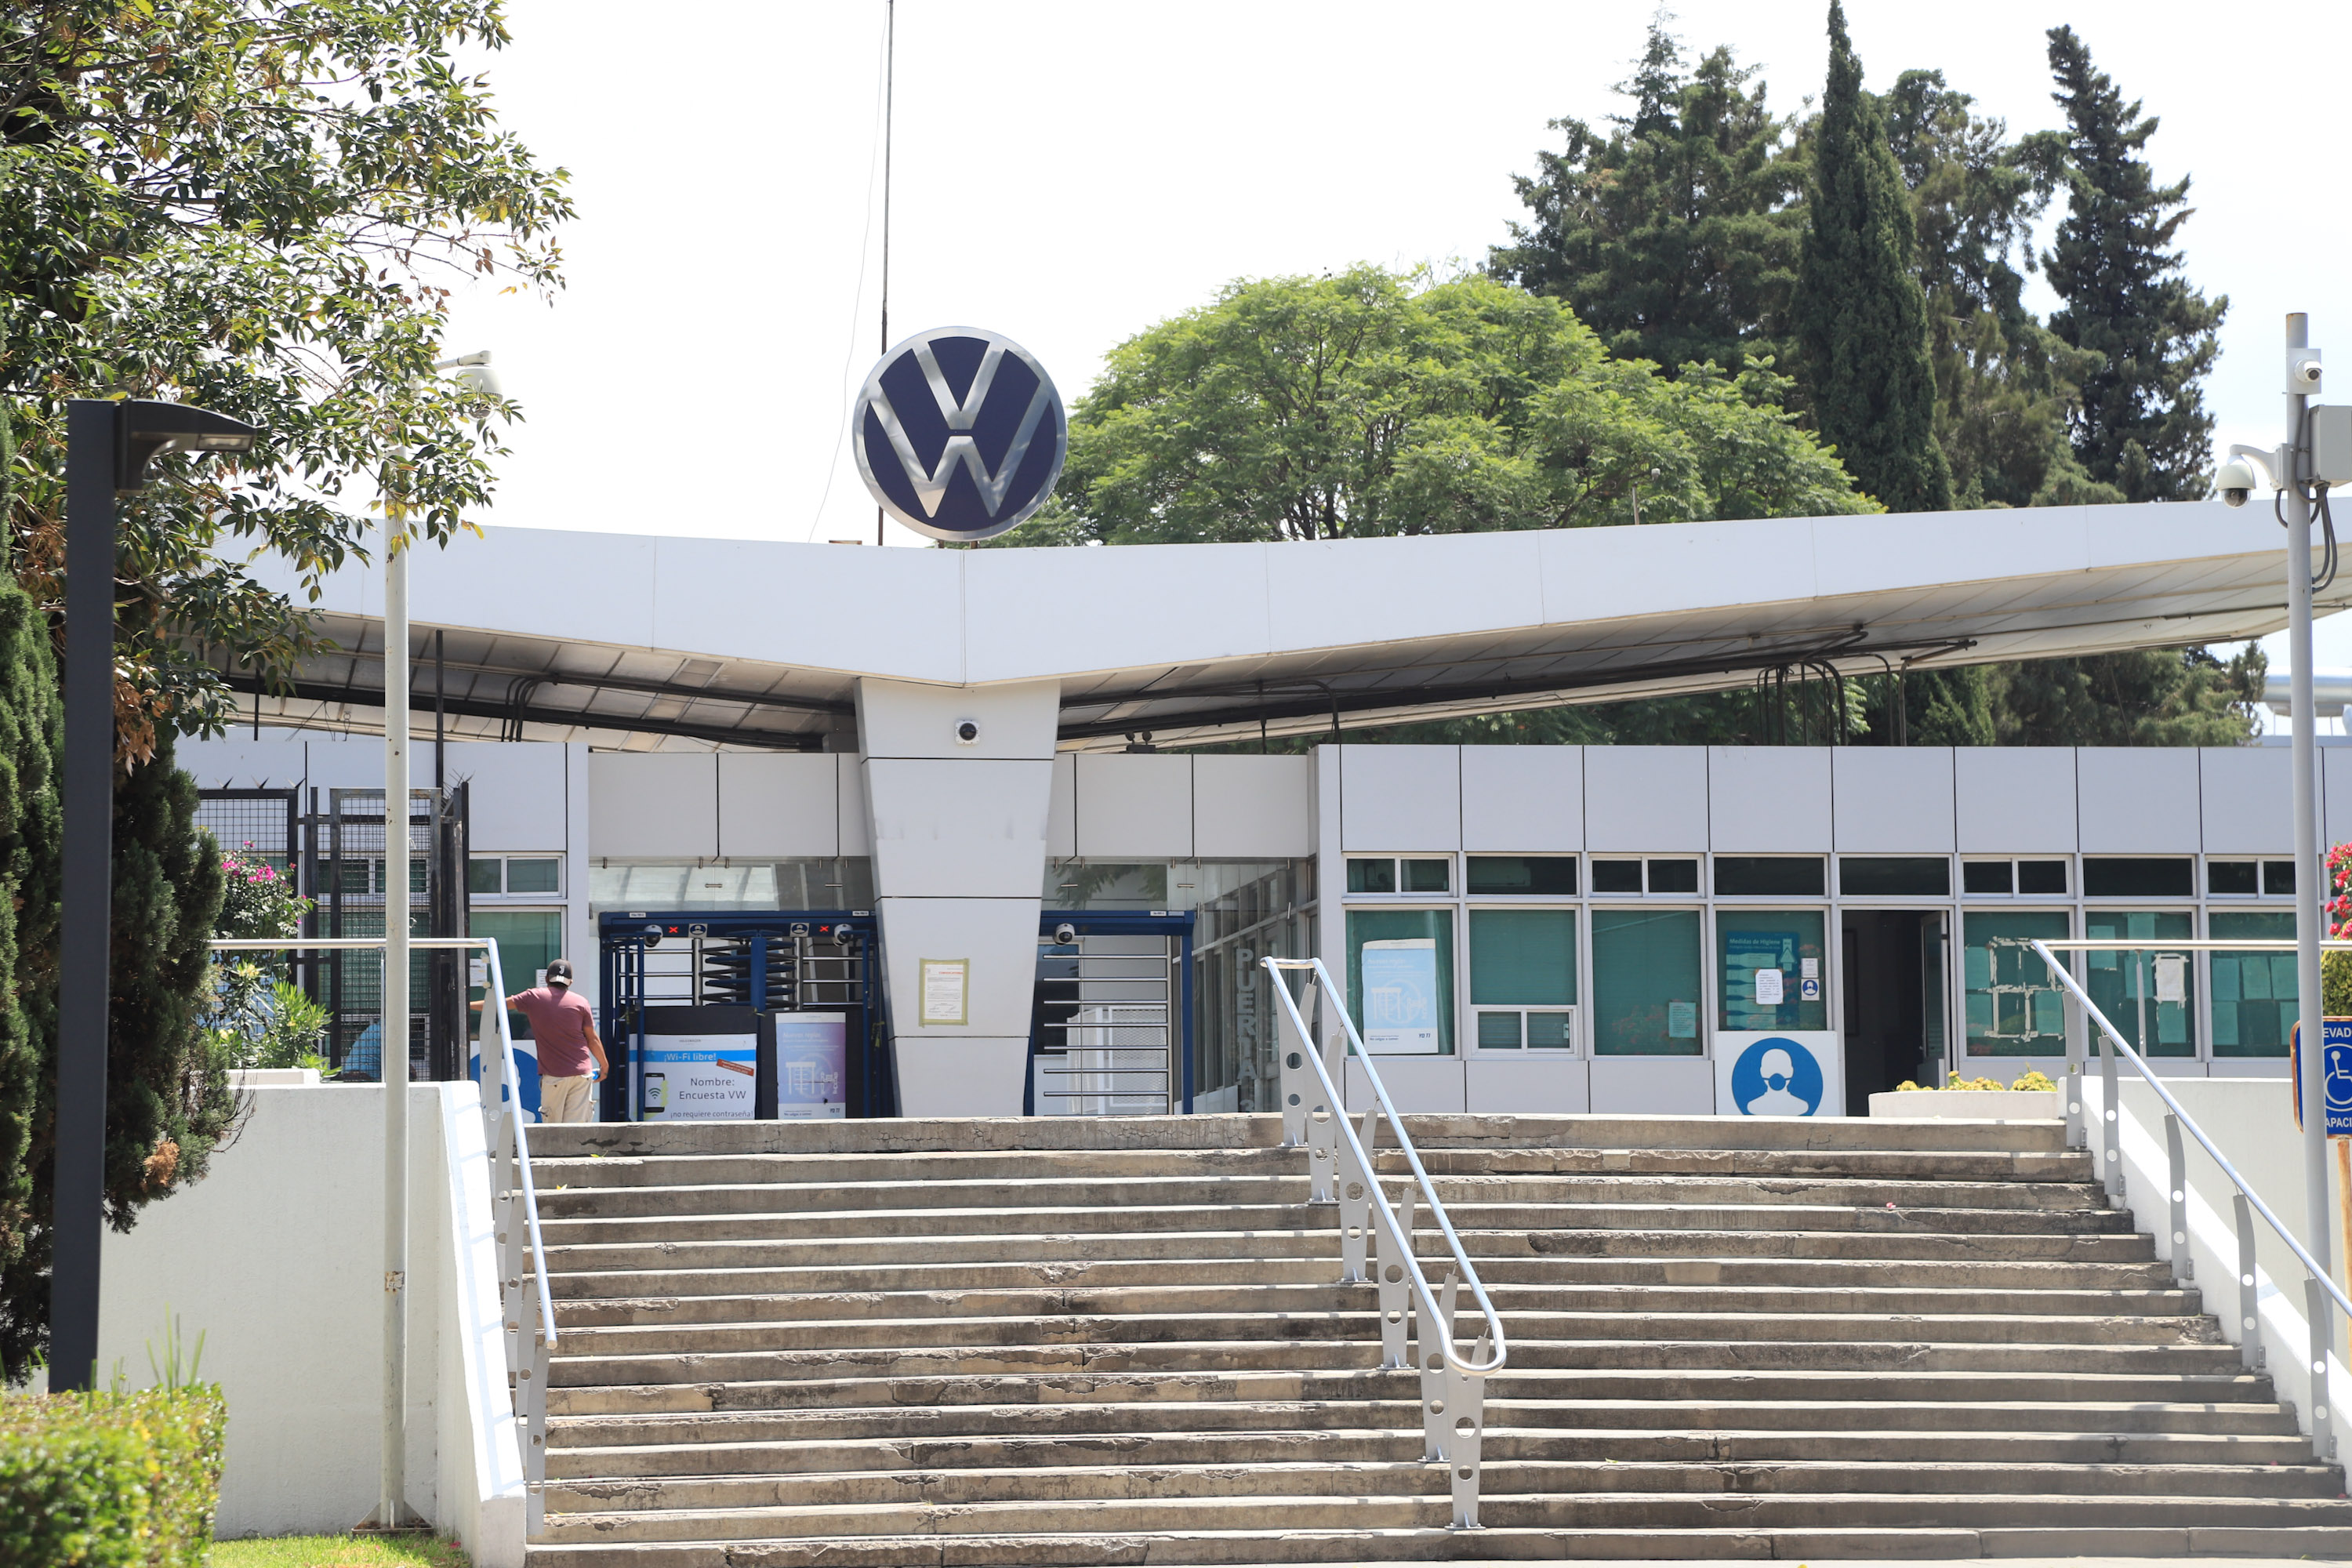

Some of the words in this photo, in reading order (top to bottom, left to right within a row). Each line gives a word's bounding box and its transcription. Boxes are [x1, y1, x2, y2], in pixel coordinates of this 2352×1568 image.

[861, 333, 1058, 527] VW
[664, 1052, 690, 1062] ¡Wi-Fi
[693, 1052, 717, 1061] libre!
[691, 1077, 735, 1087] Nombre:
[679, 1091, 725, 1100] Encuesta
[728, 1091, 746, 1099] VW
